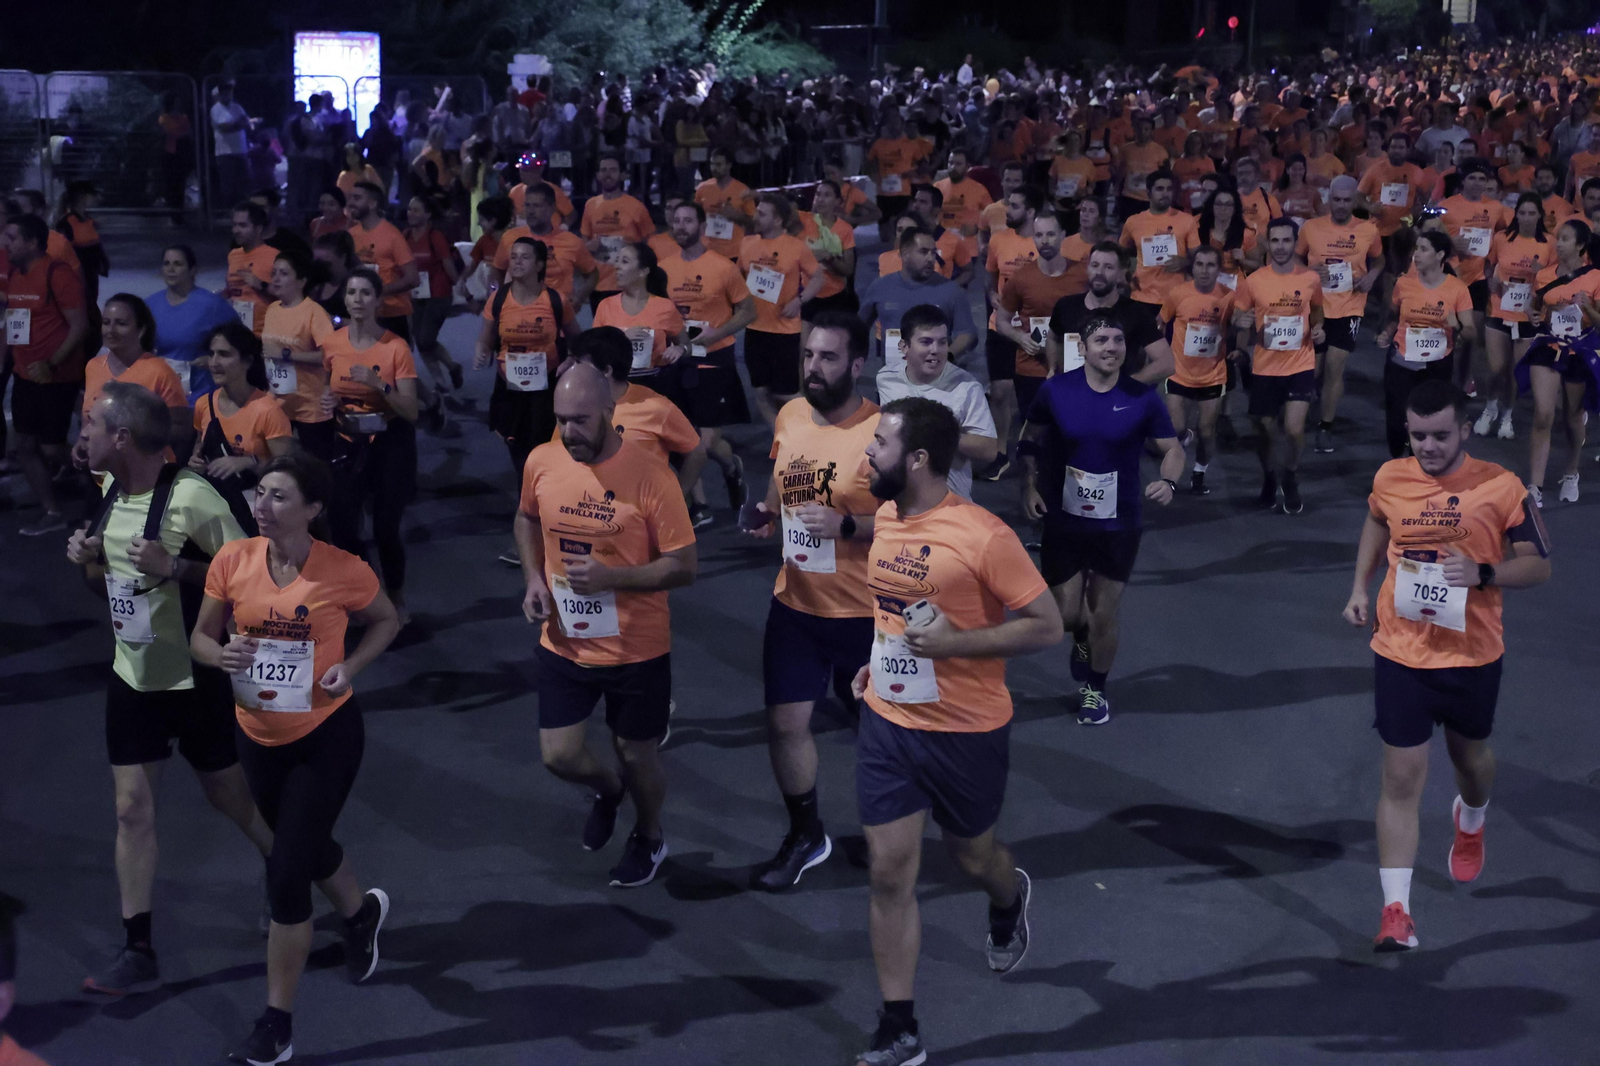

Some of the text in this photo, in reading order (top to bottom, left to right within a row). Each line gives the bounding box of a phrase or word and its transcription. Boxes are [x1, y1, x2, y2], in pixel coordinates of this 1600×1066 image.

[1151, 245, 1168, 254] 7225
[756, 276, 775, 289] 13613
[1510, 292, 1530, 300] 12917
[1272, 327, 1296, 336] 16180
[1193, 336, 1216, 345] 21564
[1414, 339, 1440, 348] 13202
[514, 366, 540, 376] 10823
[783, 471, 816, 490] CARRERA
[782, 488, 816, 506] NOCTURNA
[1077, 486, 1105, 500] 8242
[559, 506, 593, 519] SEVILLA
[577, 501, 616, 514] NOCTURNA
[1420, 511, 1462, 519] NOCTURNA
[1401, 518, 1437, 526] SEVILLA
[788, 529, 821, 549] 13020
[876, 559, 908, 577] SEVILLA
[894, 556, 930, 572] NOCTURNA
[1414, 583, 1448, 603] 7052
[111, 597, 135, 616] 233
[563, 598, 602, 614] 13026
[244, 625, 285, 637] SEVILLA
[262, 620, 312, 631] NOCTURNA
[250, 662, 298, 682] 11237
[880, 656, 919, 676] 13023
